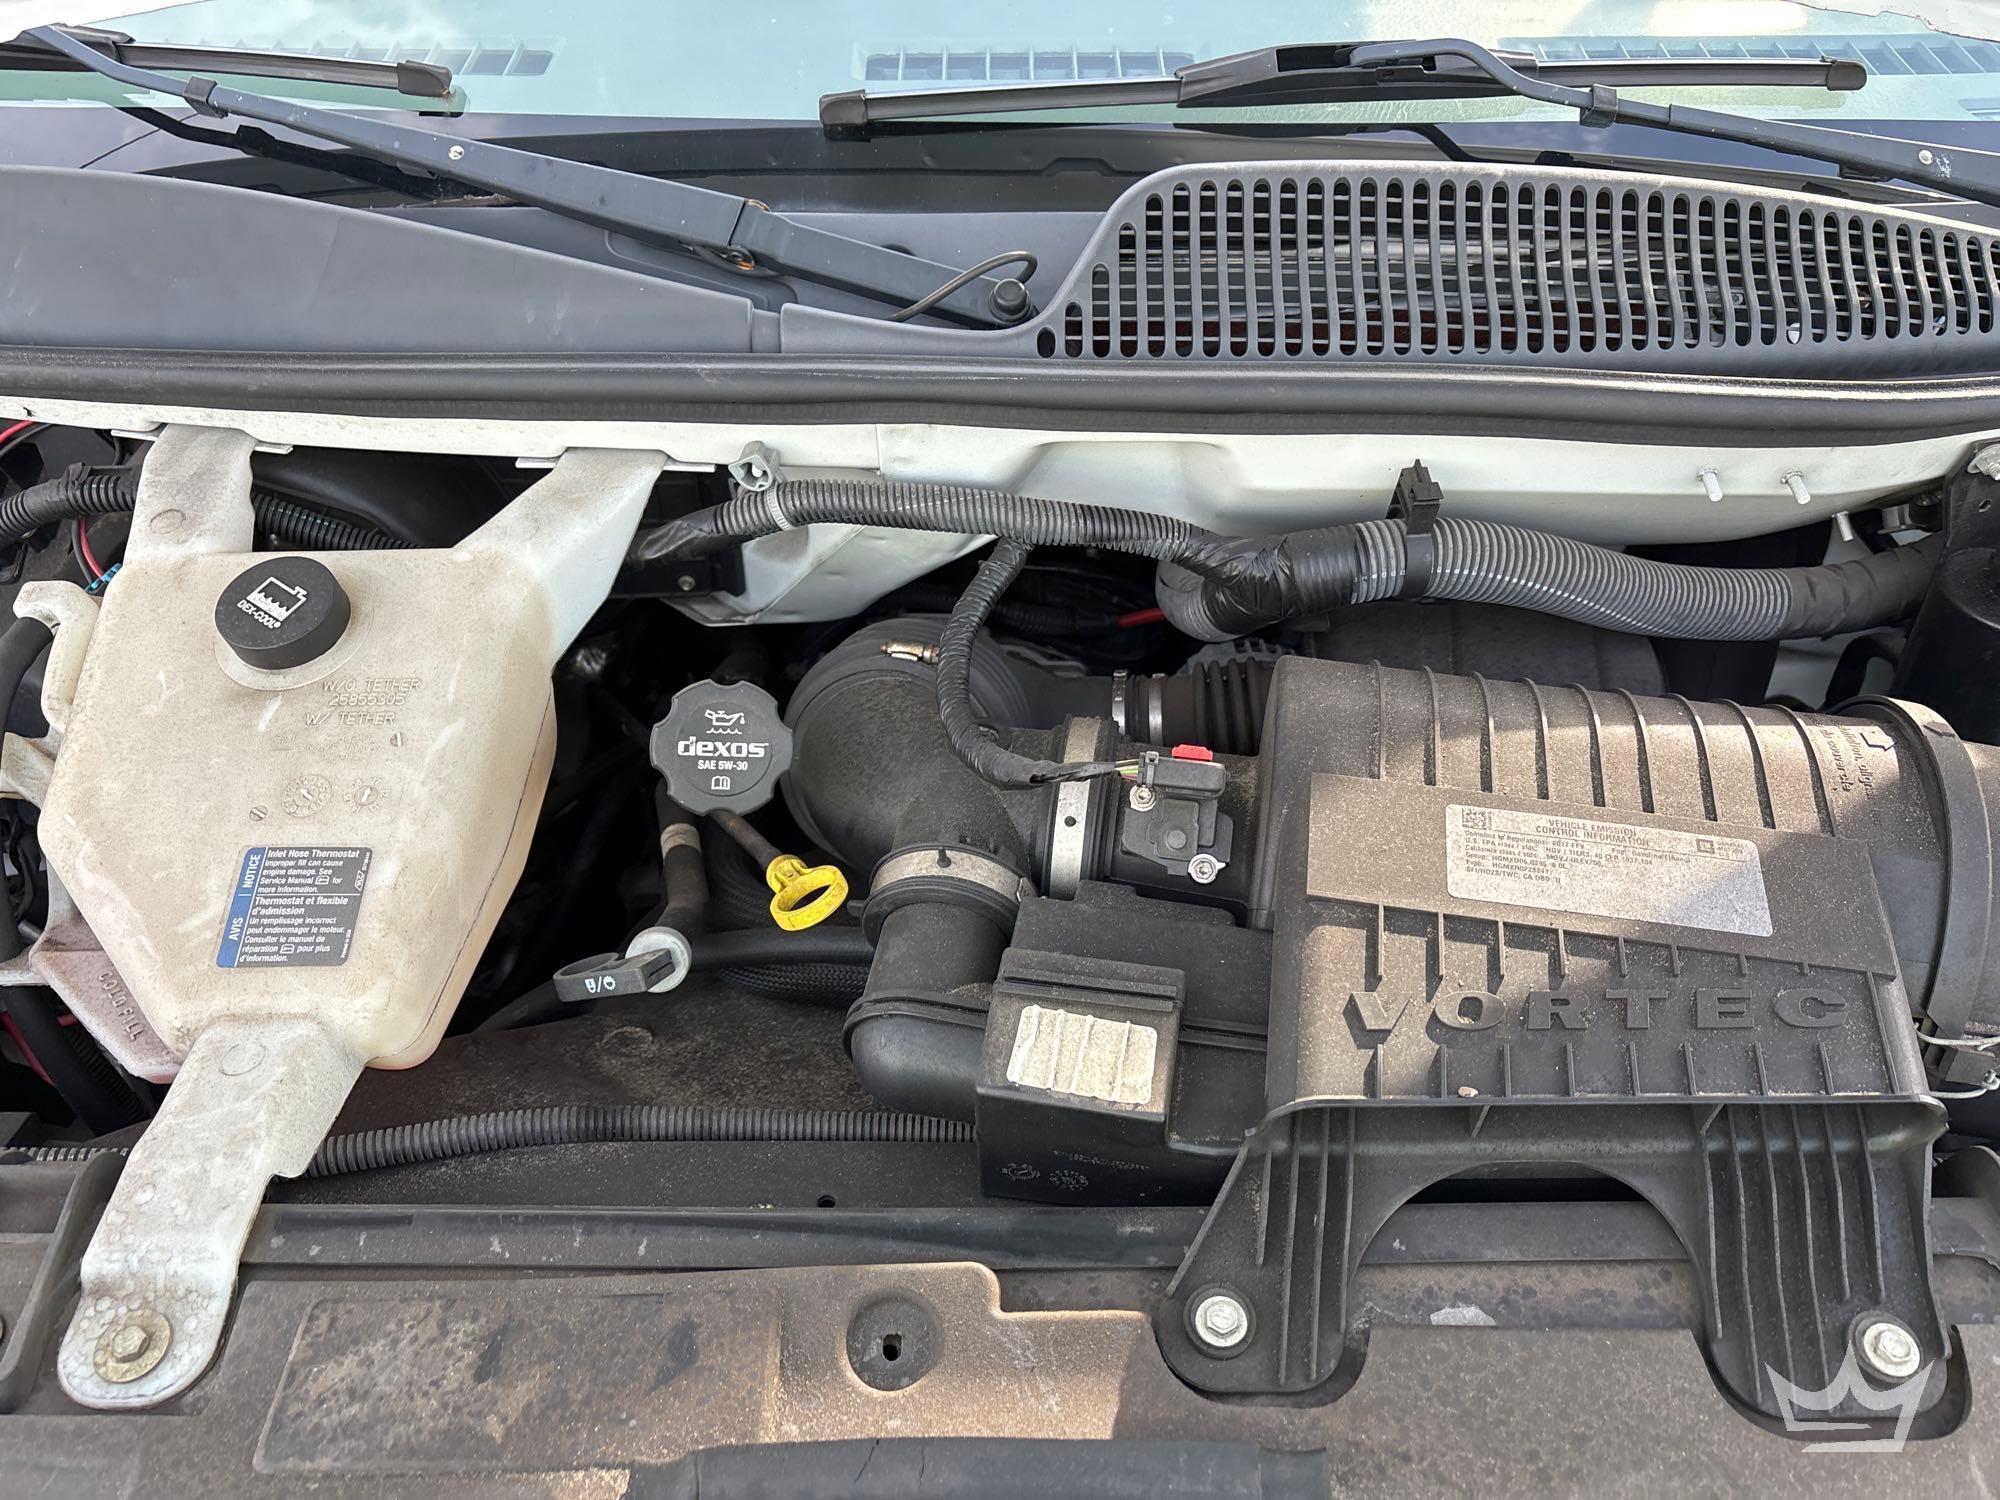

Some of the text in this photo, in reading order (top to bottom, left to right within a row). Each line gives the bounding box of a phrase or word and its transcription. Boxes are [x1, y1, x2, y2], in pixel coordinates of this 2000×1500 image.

[323, 678, 421, 692] W/O TETHER
[329, 693, 406, 706] 25855305
[338, 711, 396, 725] TETHER
[698, 760, 748, 771] SAE 5W-30
[1549, 819, 1637, 837] VEHICLE EMISSION
[1536, 825, 1650, 846] CONTROL INFORMATION
[267, 850, 360, 858] Inlet Hose Thermostat
[298, 859, 307, 867] fill
[243, 854, 261, 888] NOTICE
[287, 868, 317, 876] damage.
[255, 897, 304, 905] Thermostat
[316, 896, 348, 905] flexible
[252, 907, 304, 915] d'admission
[260, 917, 303, 925] remplissage
[229, 917, 244, 941] AVIS
[264, 926, 309, 935] endommager
[242, 945, 278, 953] réparation
[315, 945, 331, 953] plus
[1349, 987, 1851, 1031] VORTEC
